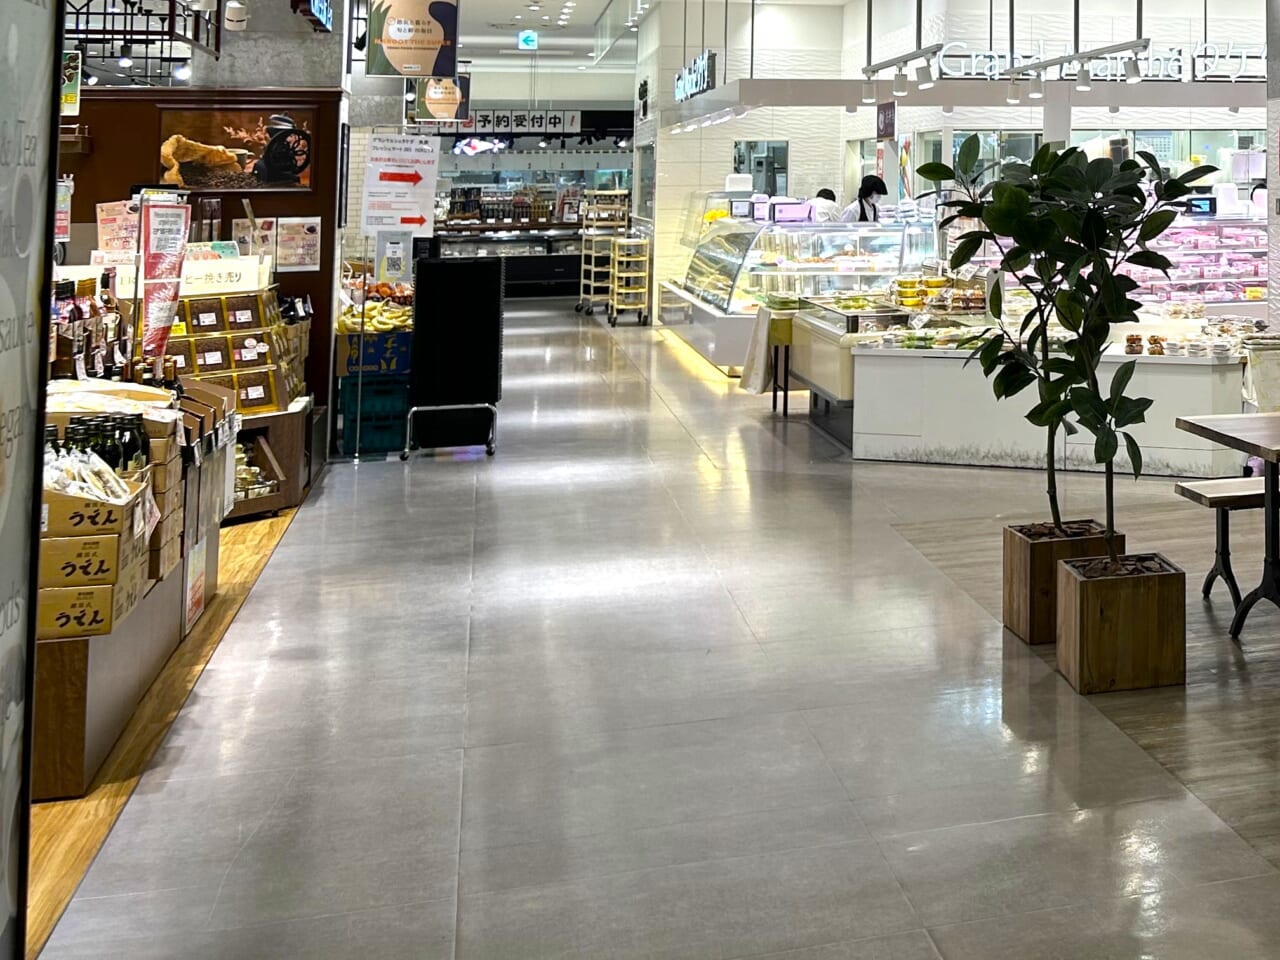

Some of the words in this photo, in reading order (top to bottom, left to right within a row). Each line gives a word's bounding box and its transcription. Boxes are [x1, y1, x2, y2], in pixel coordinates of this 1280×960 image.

[69, 509, 119, 527] うどん
[61, 559, 111, 577] うどん
[55, 609, 105, 628] うどん
